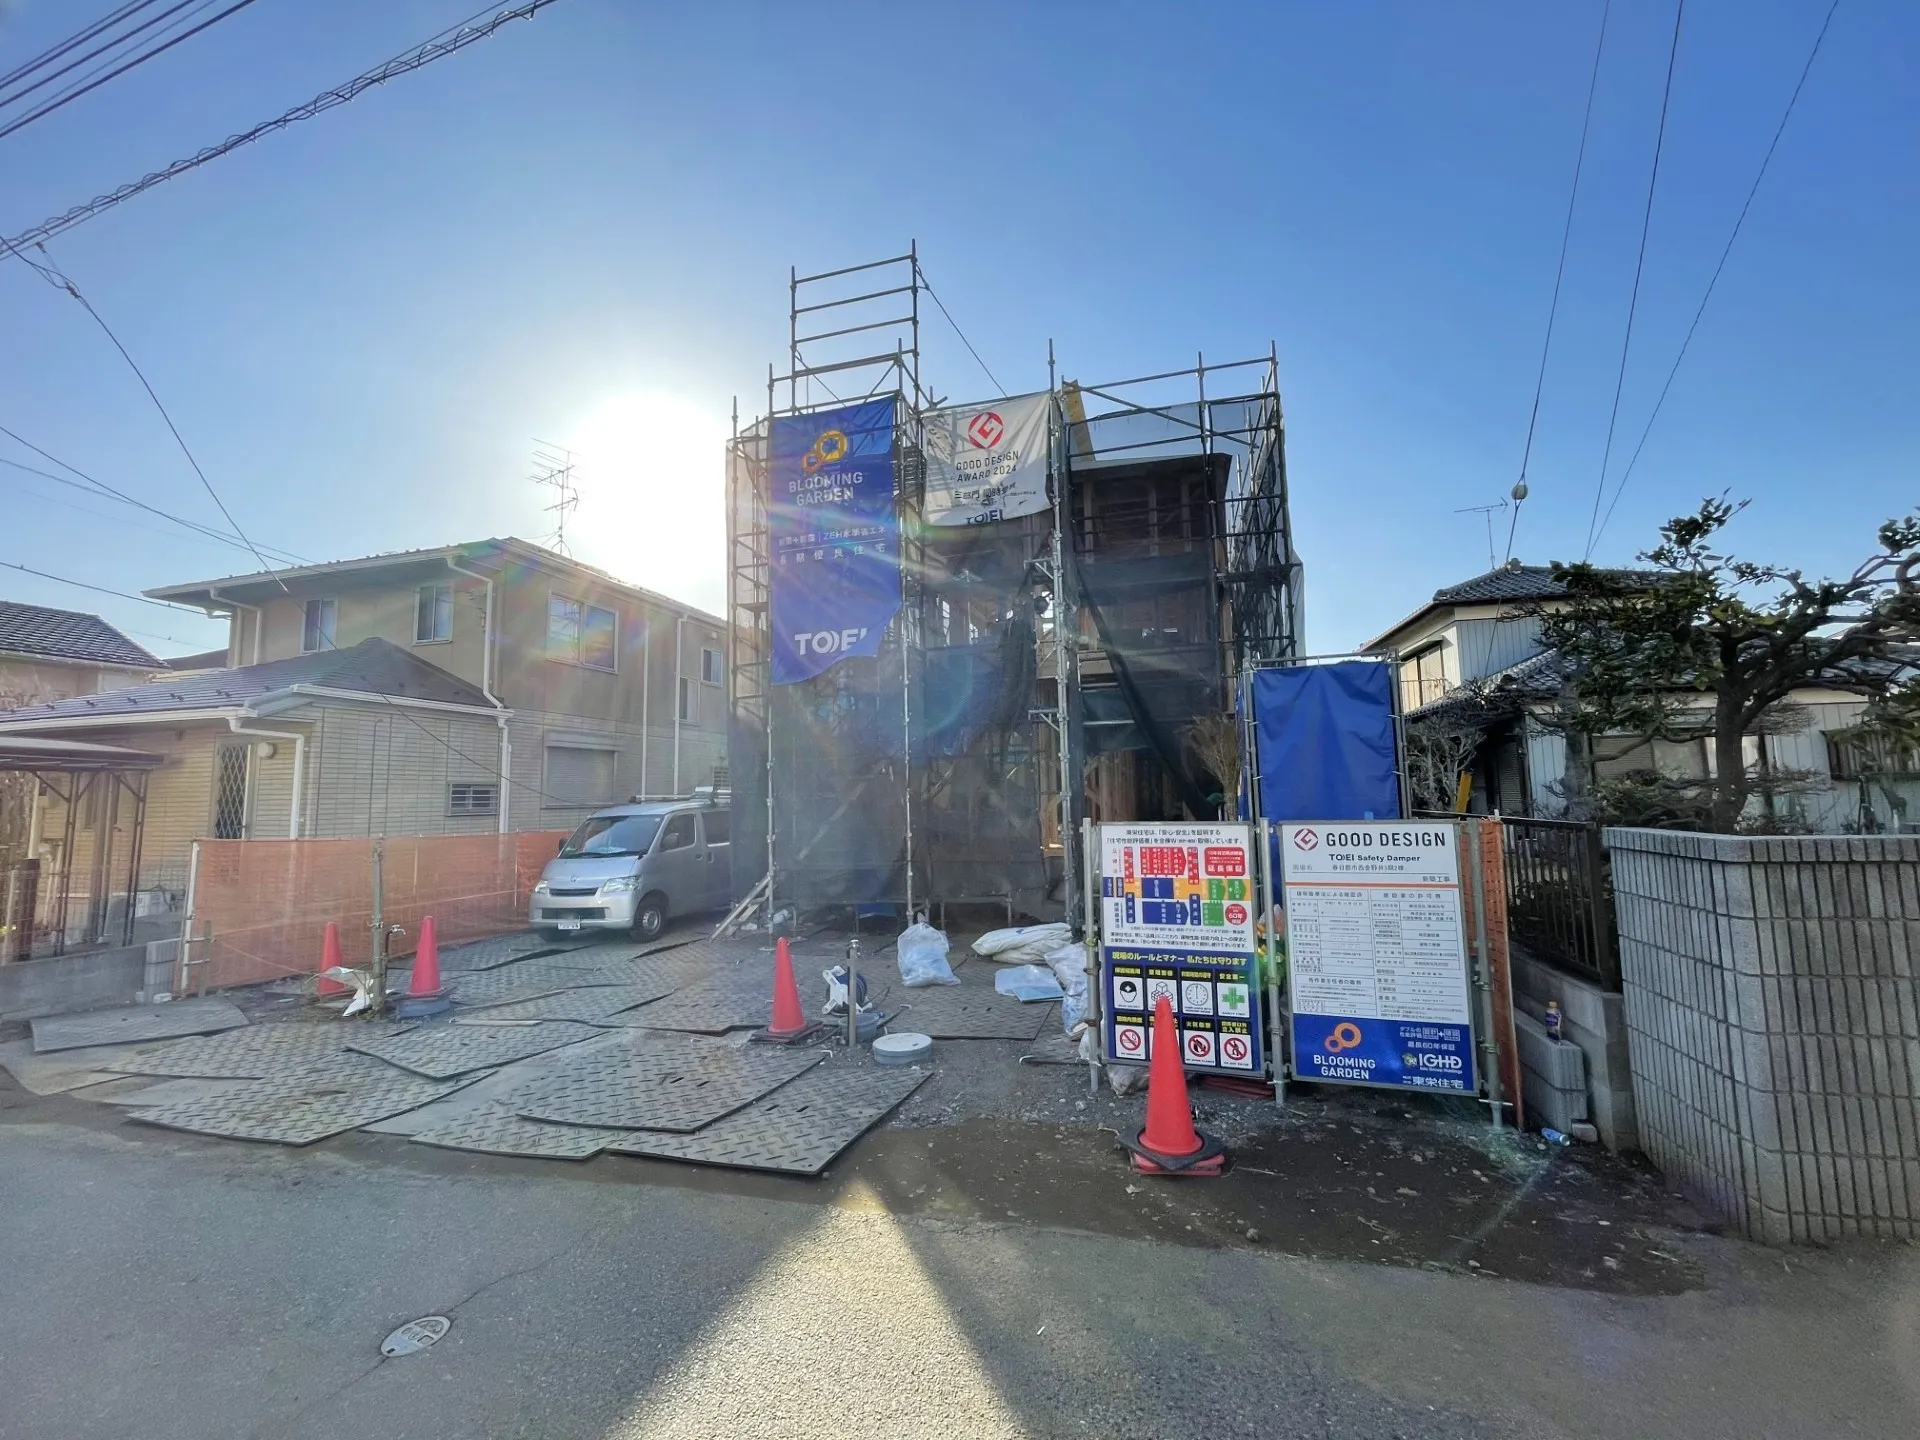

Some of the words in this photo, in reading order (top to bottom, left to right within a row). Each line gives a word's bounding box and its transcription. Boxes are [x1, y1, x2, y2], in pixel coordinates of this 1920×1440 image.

[956, 458, 982, 470] GOOD
[985, 450, 1019, 466] DESIGN
[957, 468, 990, 482] AWARD
[993, 464, 1017, 476] 2024
[789, 472, 863, 493] BLOOMING
[796, 486, 854, 506] GARDEN
[780, 543, 886, 565] 長期優良住宅
[1326, 832, 1373, 847] GOOD
[1380, 832, 1446, 847] DESIGN
[1357, 854, 1384, 863] Safety
[1387, 854, 1421, 864] Damper
[1112, 951, 1184, 962] 現場のルールとマナー
[1187, 955, 1247, 965] 私たちは守ります
[1408, 1041, 1455, 1050] 最長60年保証
[1314, 1054, 1376, 1069] BLOOMING
[1419, 1053, 1462, 1069] IGHD
[1321, 1066, 1369, 1080] GARDEN
[1412, 1076, 1464, 1089] 東栄住宅
